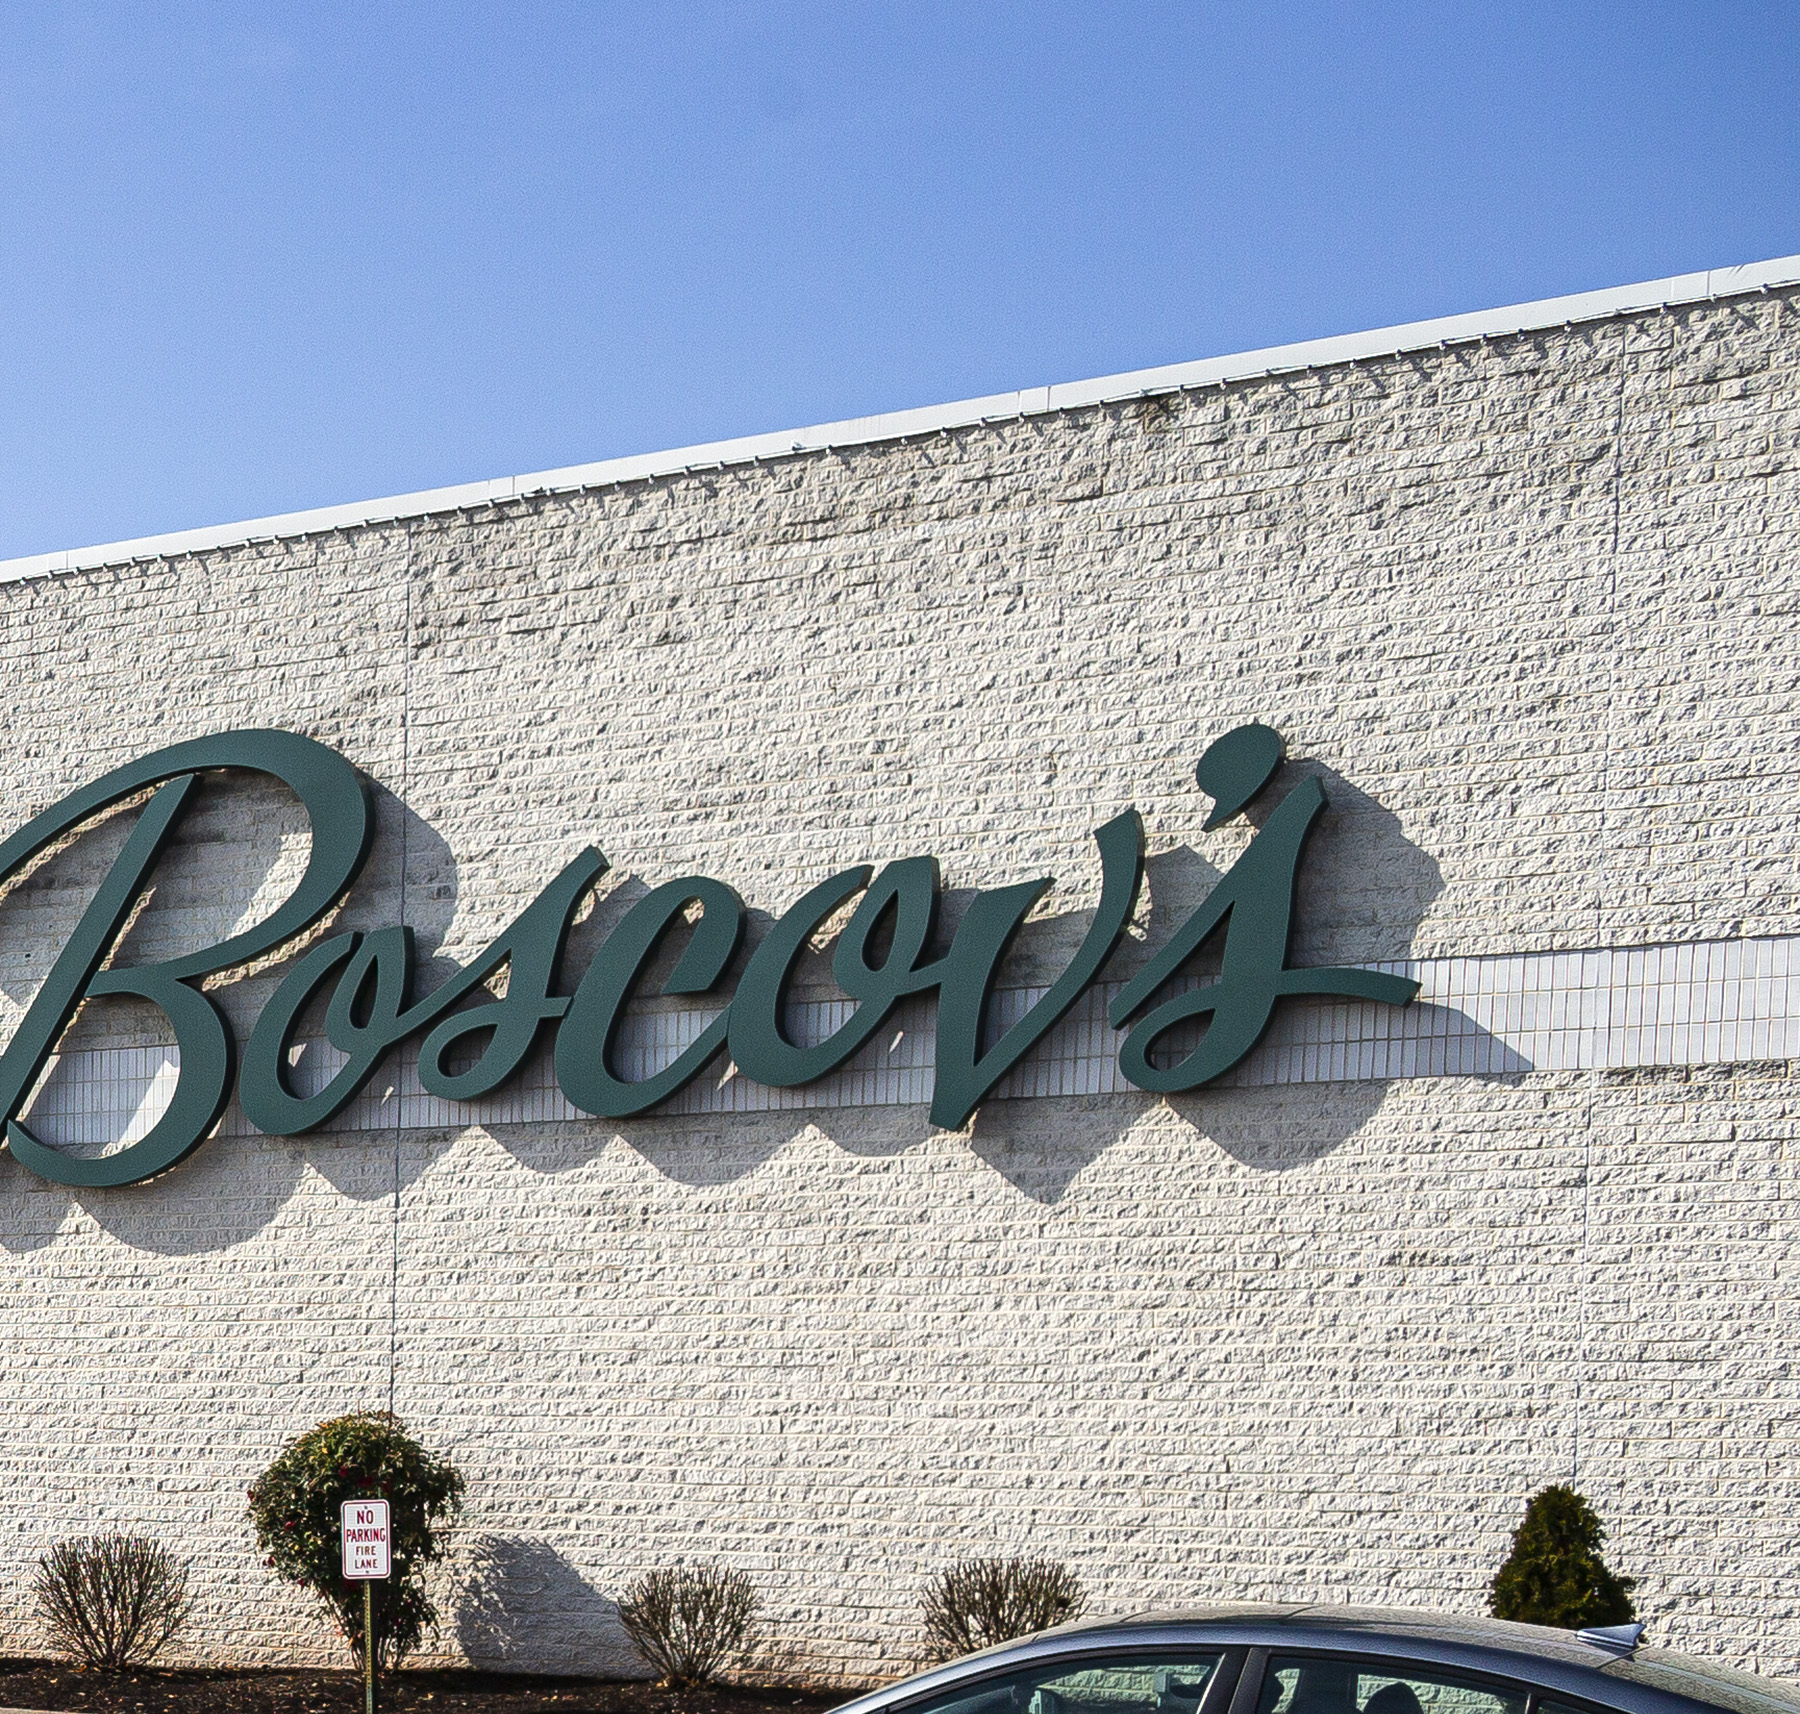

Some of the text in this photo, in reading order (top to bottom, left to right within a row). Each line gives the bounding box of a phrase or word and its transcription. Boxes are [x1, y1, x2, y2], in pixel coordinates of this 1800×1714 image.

[356, 1509, 374, 1525] NO
[346, 1527, 386, 1542] PARKING
[355, 1545, 377, 1556] FIRE
[354, 1558, 378, 1569] LANE
